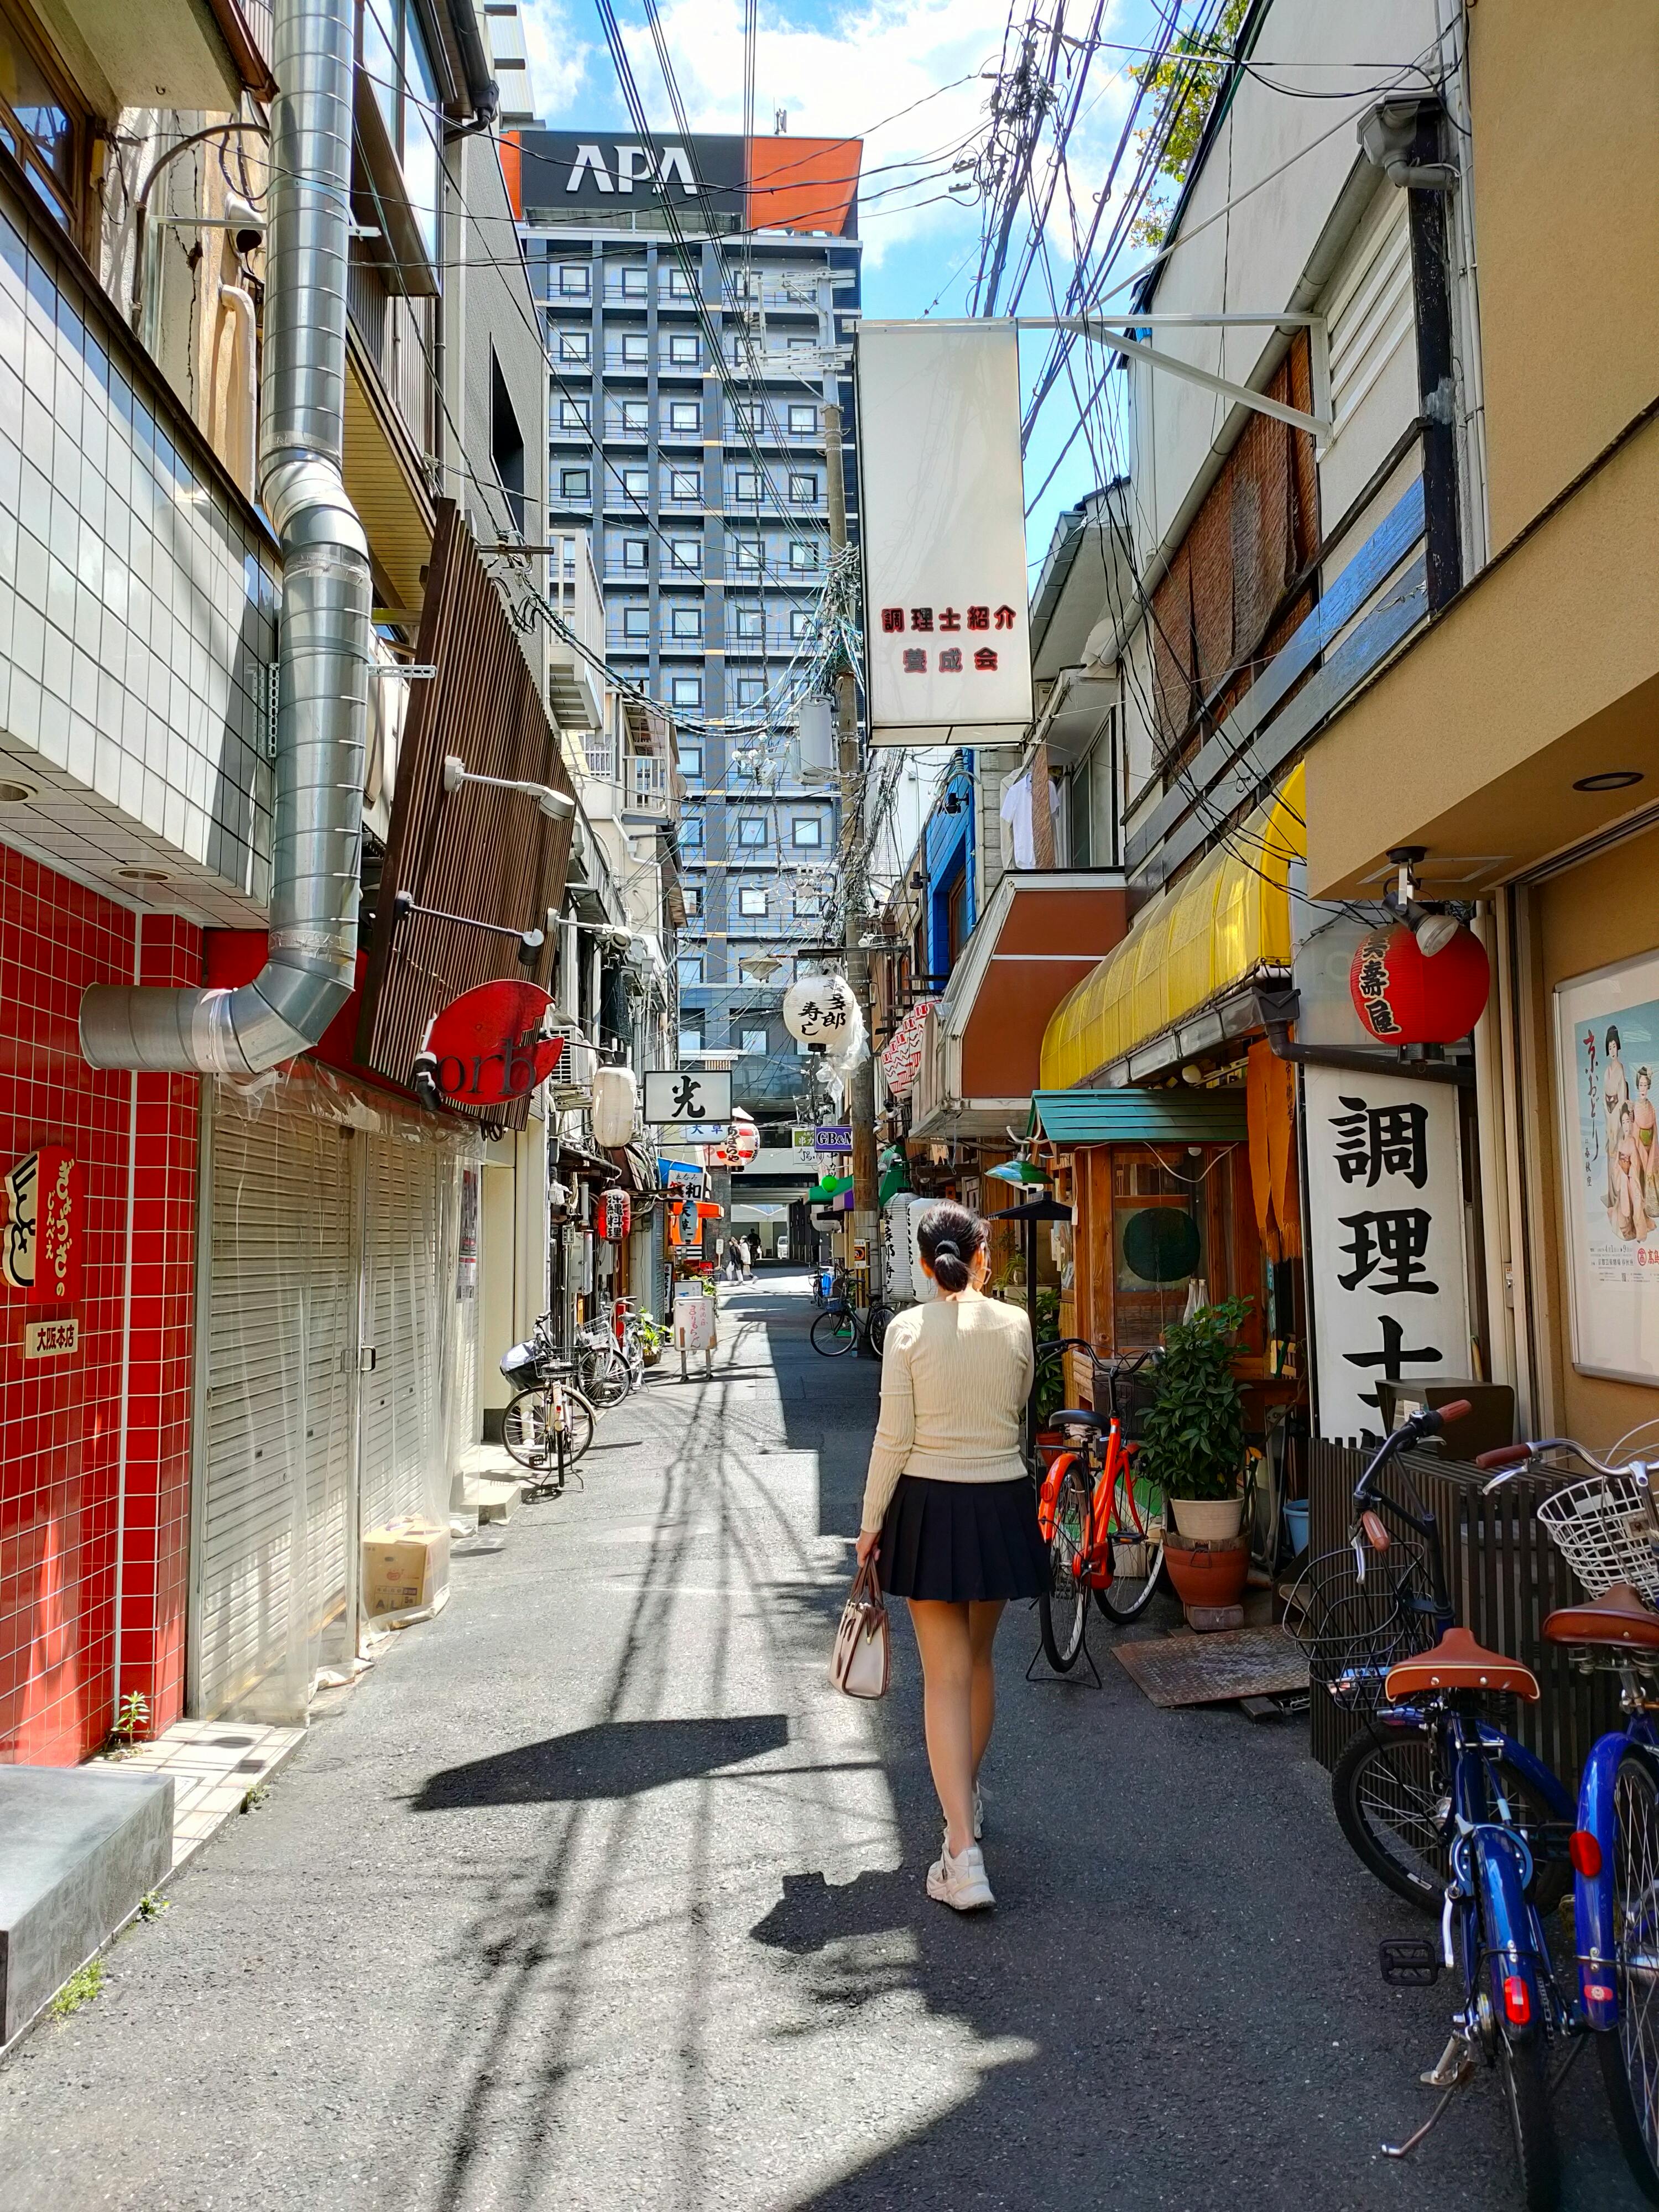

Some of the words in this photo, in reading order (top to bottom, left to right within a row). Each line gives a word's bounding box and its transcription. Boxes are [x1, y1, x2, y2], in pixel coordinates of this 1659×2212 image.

[566, 144, 698, 195] APA
[881, 604, 1016, 633] 調理士紹介
[798, 1001, 824, 1036] 寿し
[436, 1038, 537, 1095] orb
[671, 1075, 706, 1118] 光
[45, 1190, 55, 1260] じんべえ
[54, 1158, 75, 1297] ぎょうざの
[607, 1194, 623, 1238] 沖縄料理
[36, 1324, 75, 1352] 大阪本店
